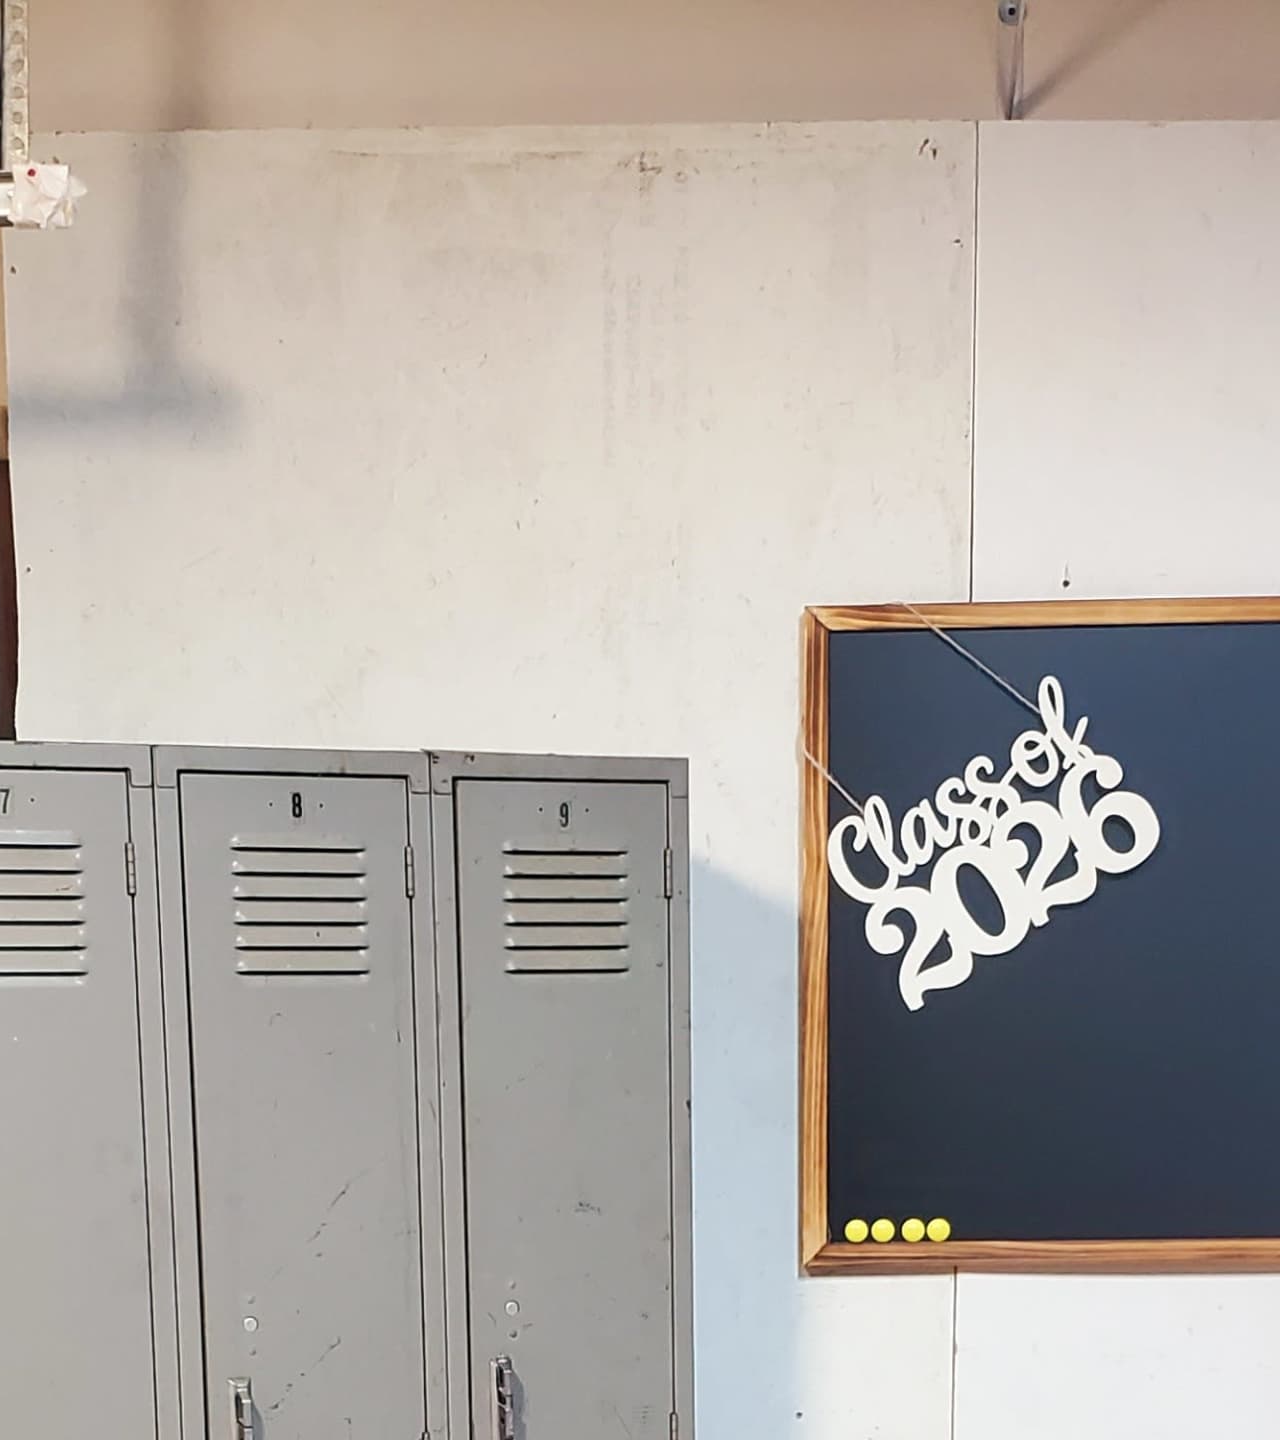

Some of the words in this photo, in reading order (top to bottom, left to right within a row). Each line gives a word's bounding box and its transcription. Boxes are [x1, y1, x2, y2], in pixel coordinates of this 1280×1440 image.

[0, 788, 10, 814] 7
[827, 755, 1020, 904] Class
[1006, 675, 1093, 789] of
[291, 792, 303, 818] 8
[560, 802, 569, 828] 9
[865, 754, 1161, 1012] 2026
